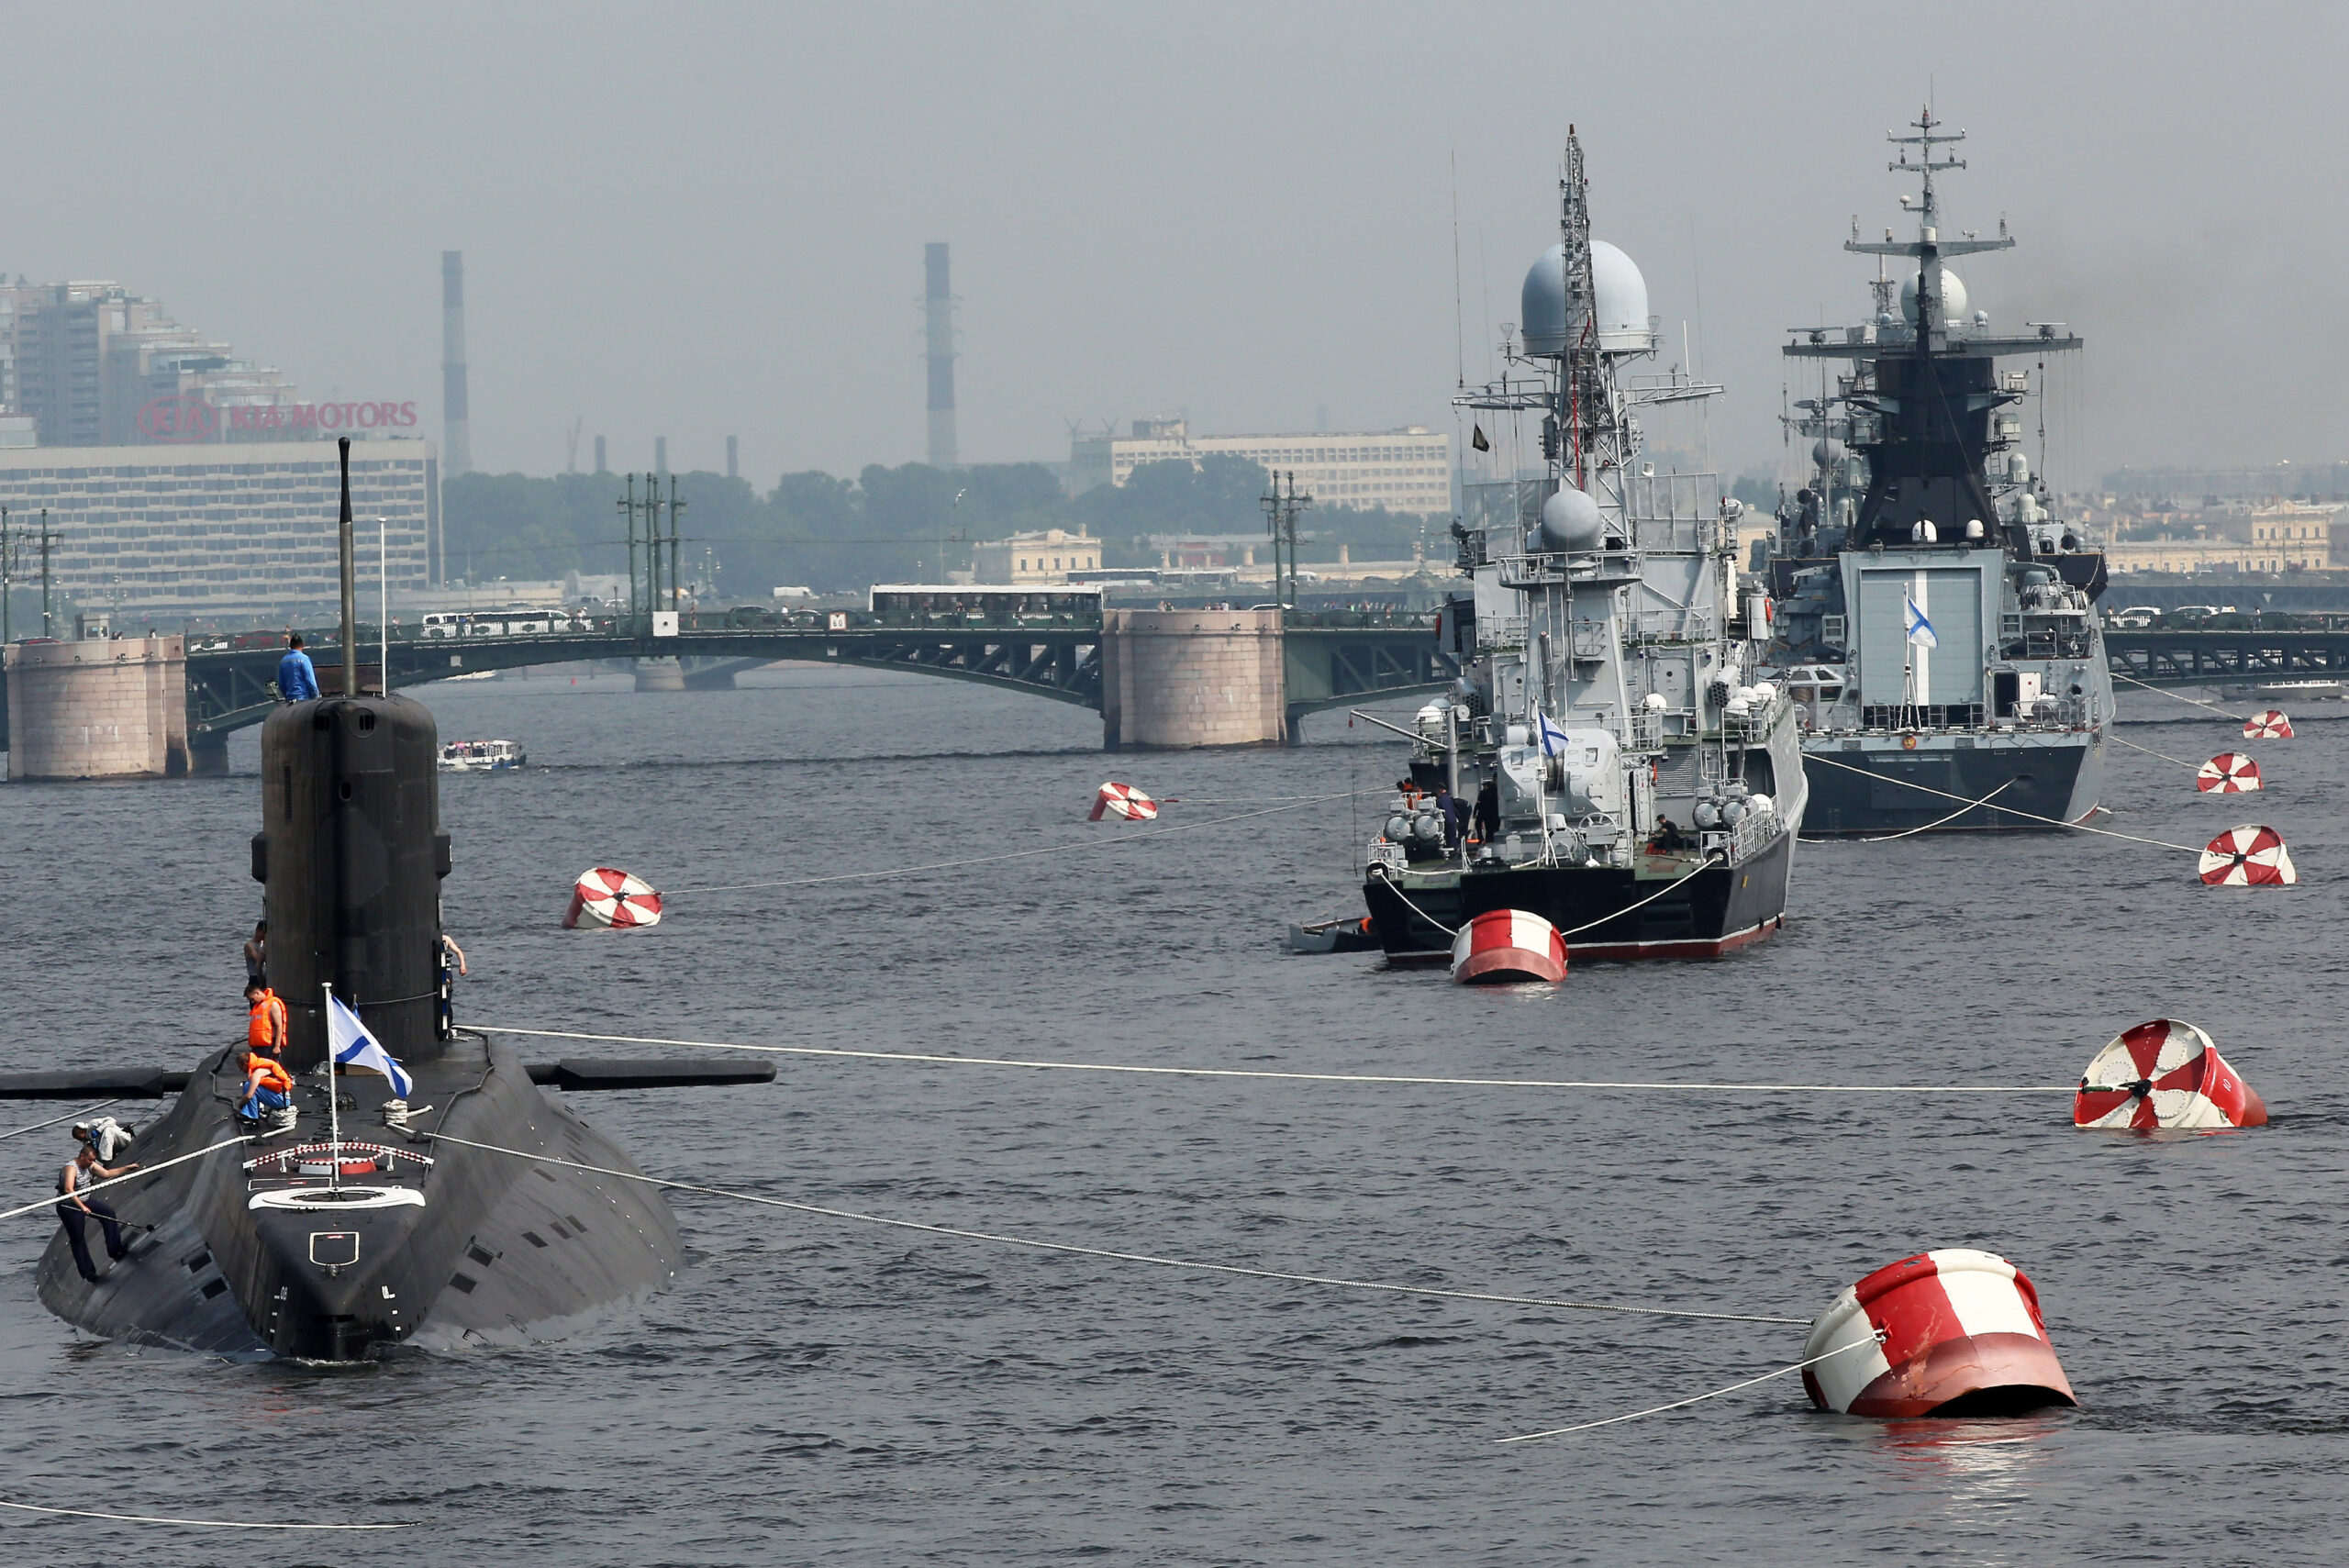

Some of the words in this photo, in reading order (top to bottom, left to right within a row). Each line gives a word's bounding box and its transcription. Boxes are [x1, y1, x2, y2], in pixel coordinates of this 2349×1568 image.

[152, 406, 206, 431] KIA
[231, 405, 283, 429] KIA
[291, 401, 417, 429] MOTORS
